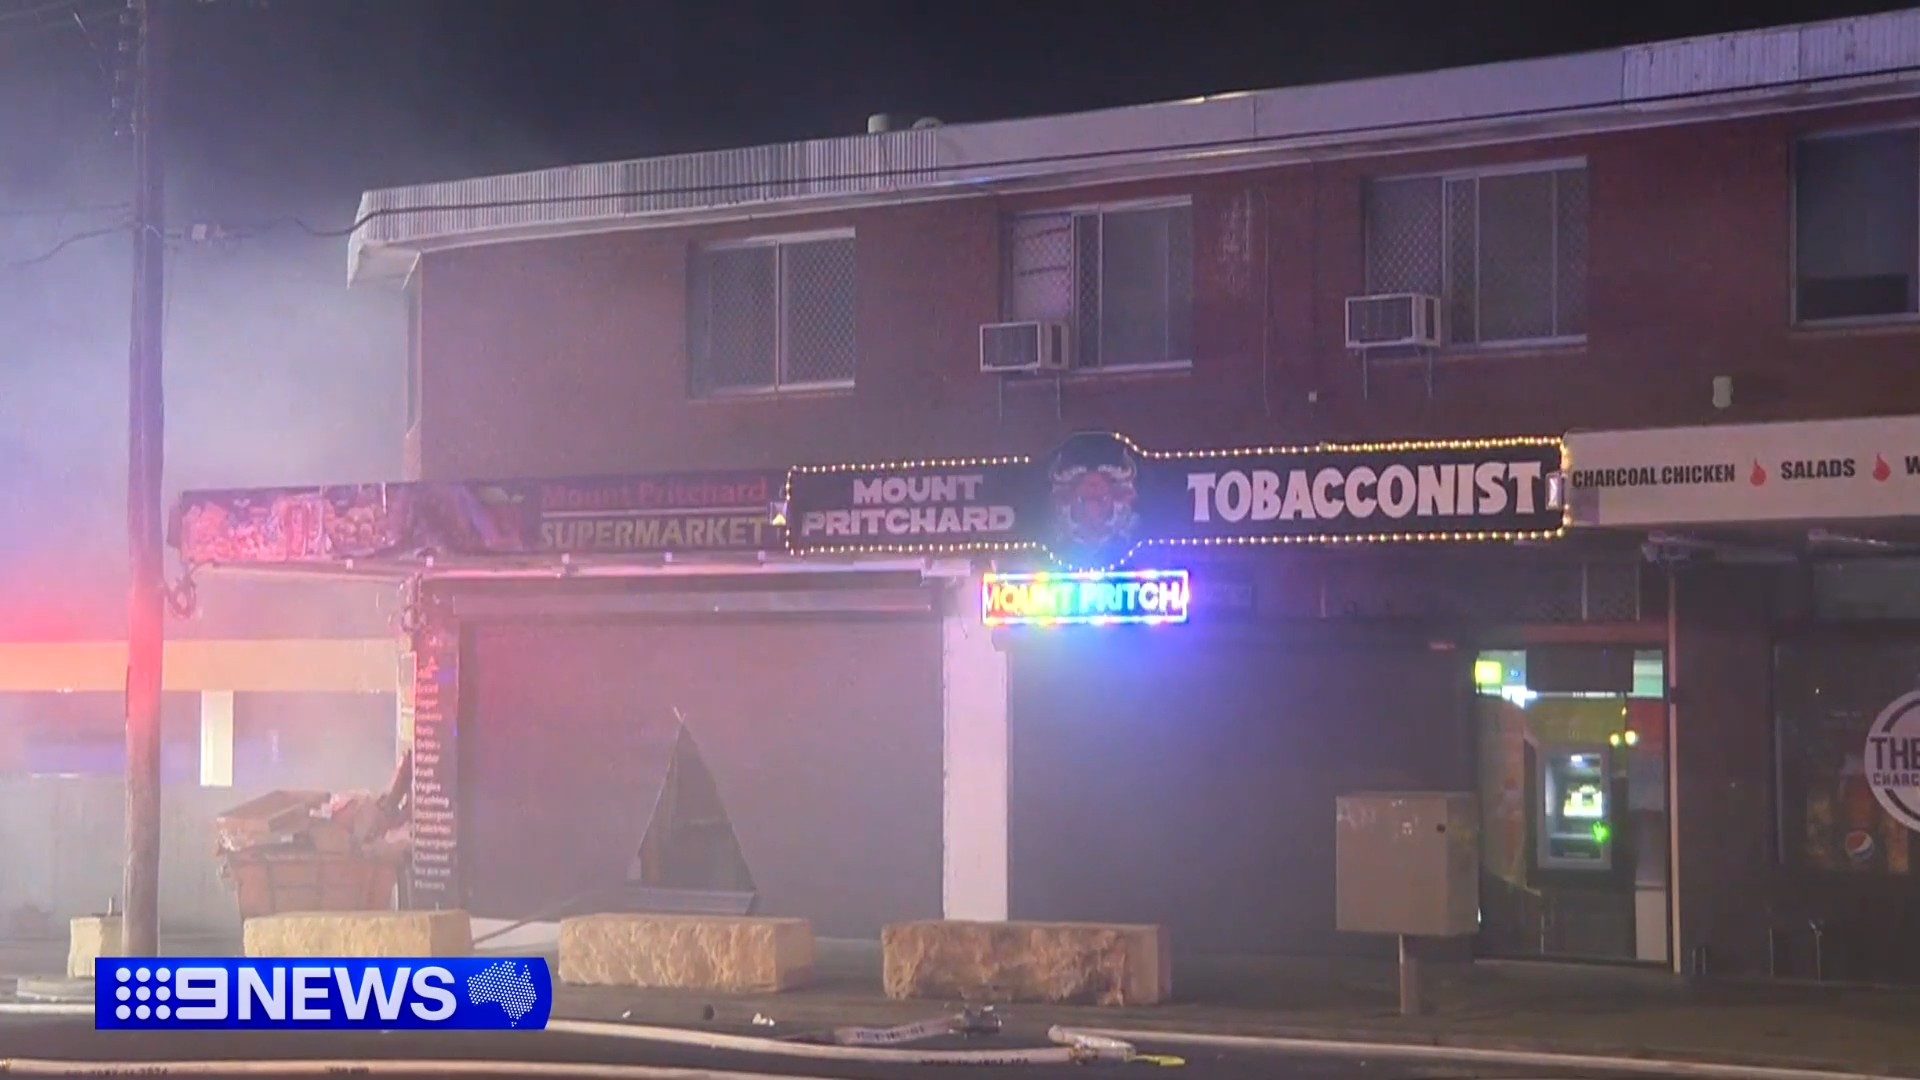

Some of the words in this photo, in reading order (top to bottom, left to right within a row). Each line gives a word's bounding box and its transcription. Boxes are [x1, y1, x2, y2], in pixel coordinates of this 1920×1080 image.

[852, 474, 984, 504] MOUNT
[1572, 467, 1658, 489] CHARCOAL
[1662, 464, 1736, 486] CHICKEN
[1781, 458, 1856, 480] SALADS
[541, 485, 631, 509] Mount
[637, 475, 768, 505] Pritchard
[1187, 461, 1542, 523] TOBACCONIST
[540, 515, 769, 549] SUPERMARKET
[801, 505, 1016, 537] PRITCHARD
